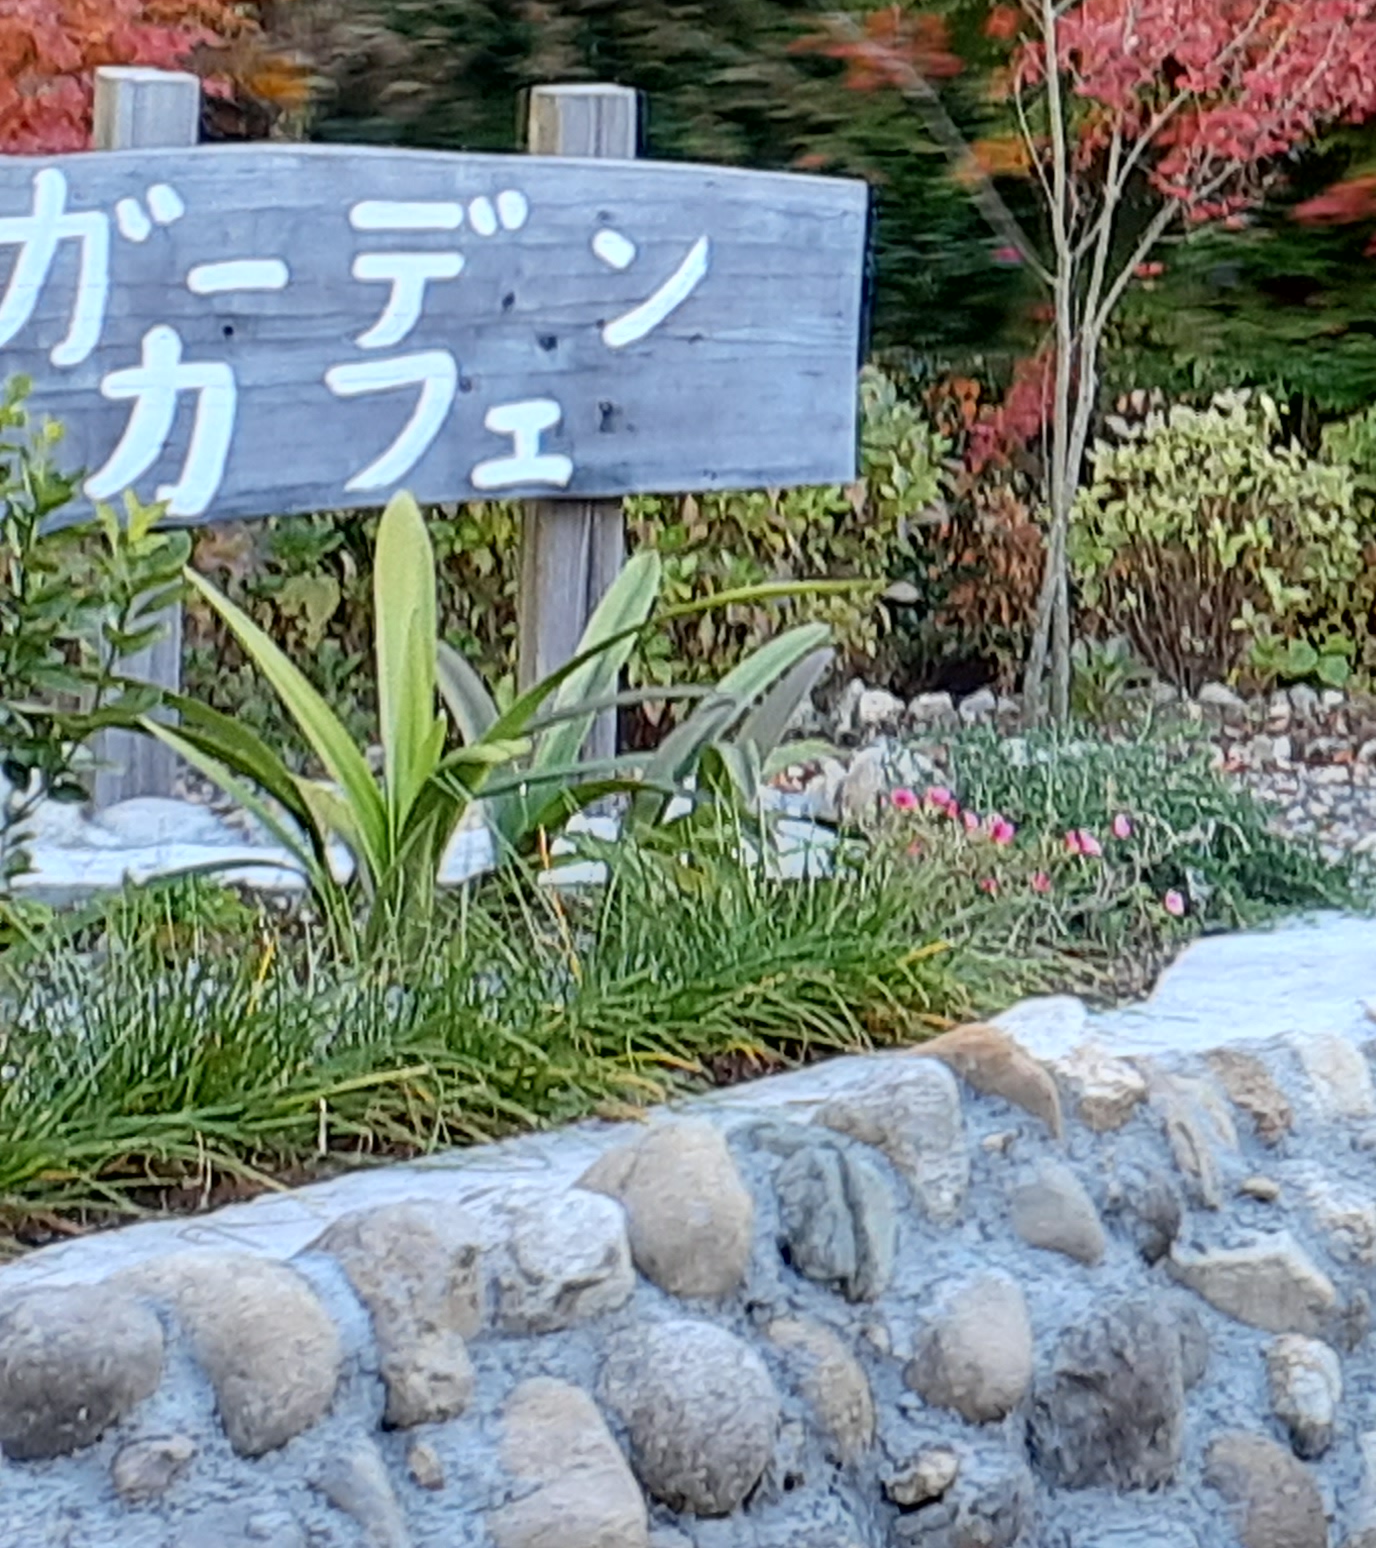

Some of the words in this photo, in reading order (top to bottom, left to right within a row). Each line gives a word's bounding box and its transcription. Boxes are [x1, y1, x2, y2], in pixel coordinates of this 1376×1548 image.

[0, 169, 710, 366] ガーデン
[84, 325, 574, 517] カフェ
